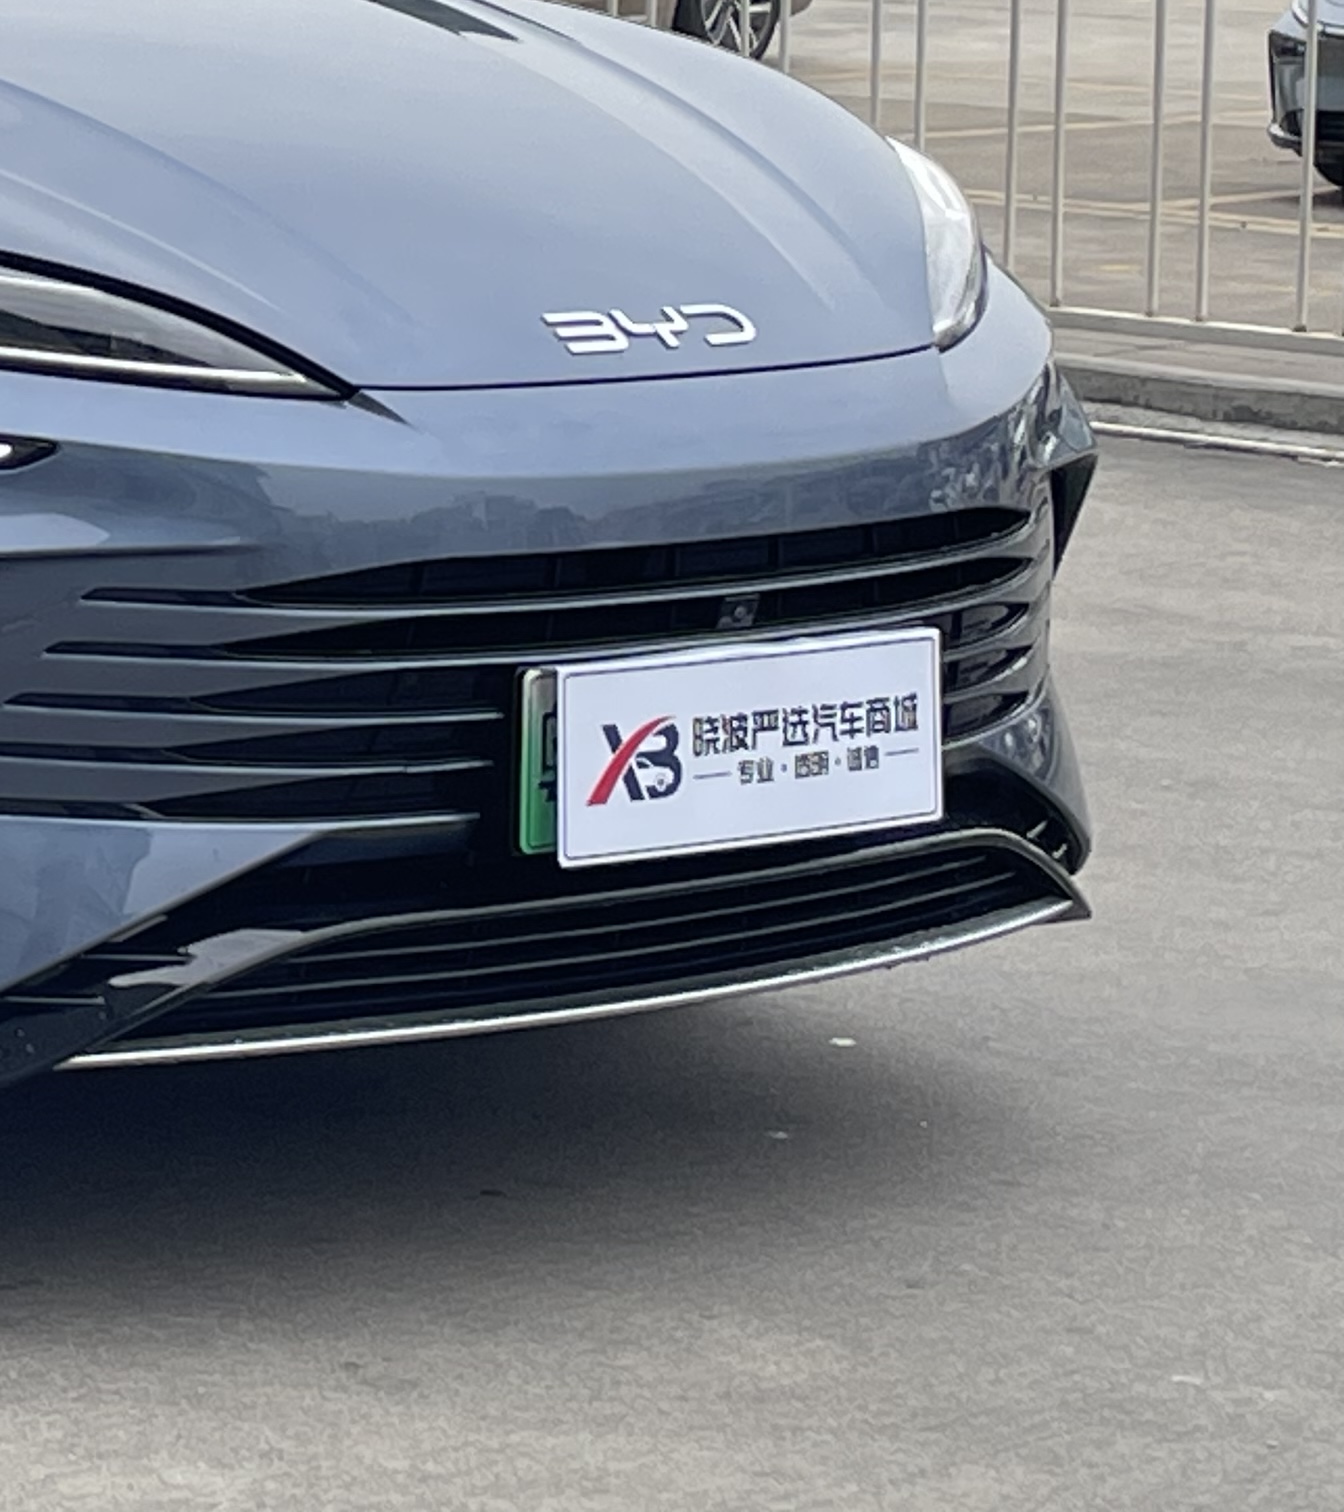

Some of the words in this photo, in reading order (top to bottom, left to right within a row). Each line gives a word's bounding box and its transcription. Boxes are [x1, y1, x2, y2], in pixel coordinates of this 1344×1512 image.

[541, 303, 756, 355] BYD
[691, 691, 919, 758] 晓波严选汽车商城
